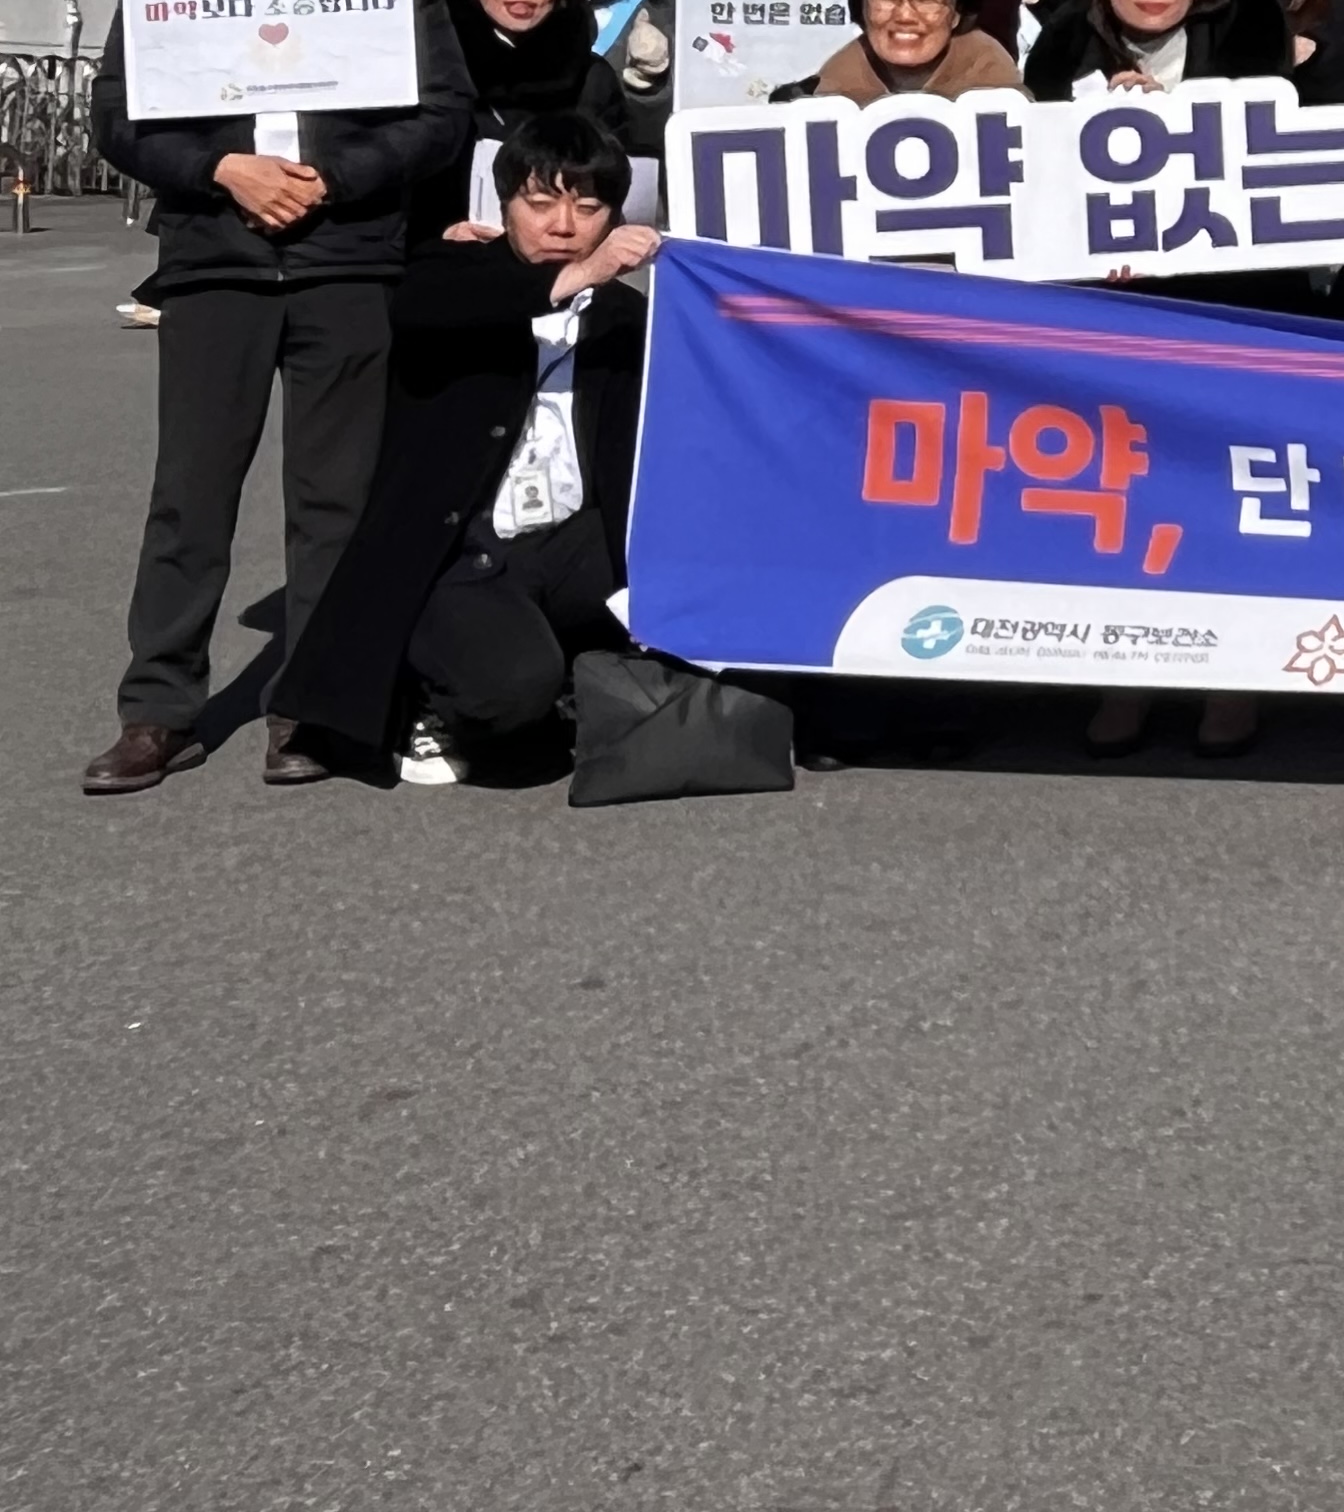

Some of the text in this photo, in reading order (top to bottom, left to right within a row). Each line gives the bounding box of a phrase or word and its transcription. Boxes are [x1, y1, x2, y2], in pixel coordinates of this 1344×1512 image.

[691, 111, 1024, 261] 마약
[862, 391, 1184, 575] 마약,
[1229, 442, 1321, 538] 단
[970, 617, 1092, 644] 대전광역시
